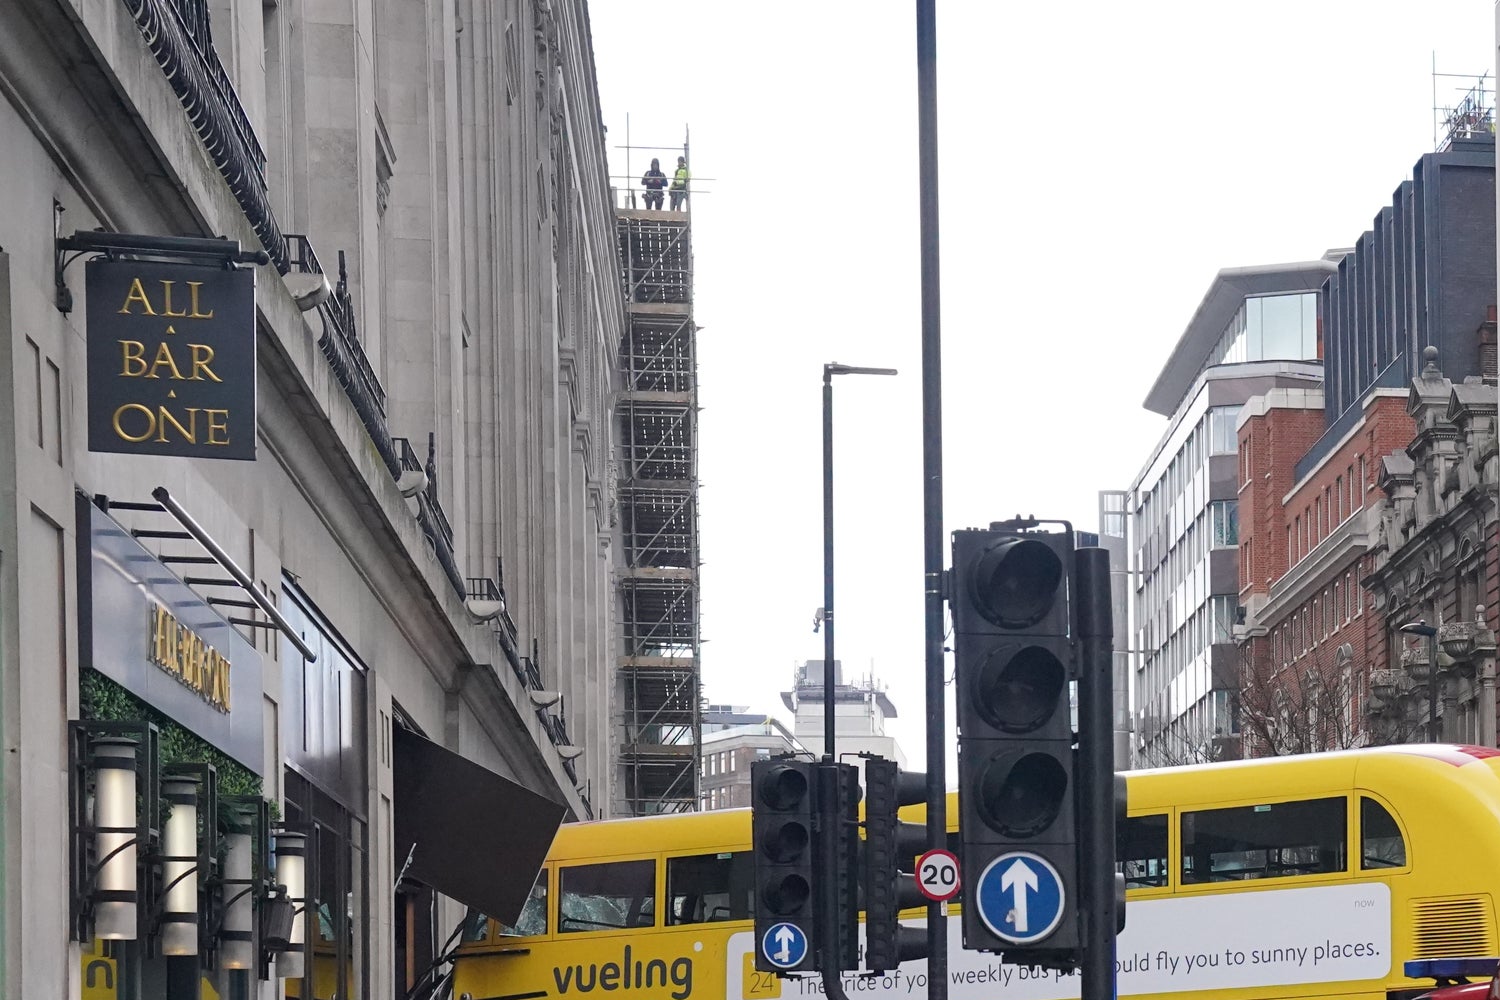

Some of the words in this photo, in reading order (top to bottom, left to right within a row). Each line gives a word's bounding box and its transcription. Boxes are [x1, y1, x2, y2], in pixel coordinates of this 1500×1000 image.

[115, 277, 214, 320] ALL
[117, 339, 224, 383] BAR
[112, 402, 231, 446] ONE
[923, 864, 955, 885] 20
[1354, 898, 1375, 908] now
[553, 944, 693, 1000] vueling
[750, 972, 774, 994] 24
[843, 965, 877, 992] rice
[882, 970, 902, 990] of
[951, 963, 1013, 988] weekly
[1115, 951, 1150, 974] ould
[1156, 951, 1179, 976] fly
[1185, 952, 1219, 975] you
[1226, 949, 1246, 967] to
[1251, 945, 1308, 967] sunny
[1314, 939, 1381, 966] places.
